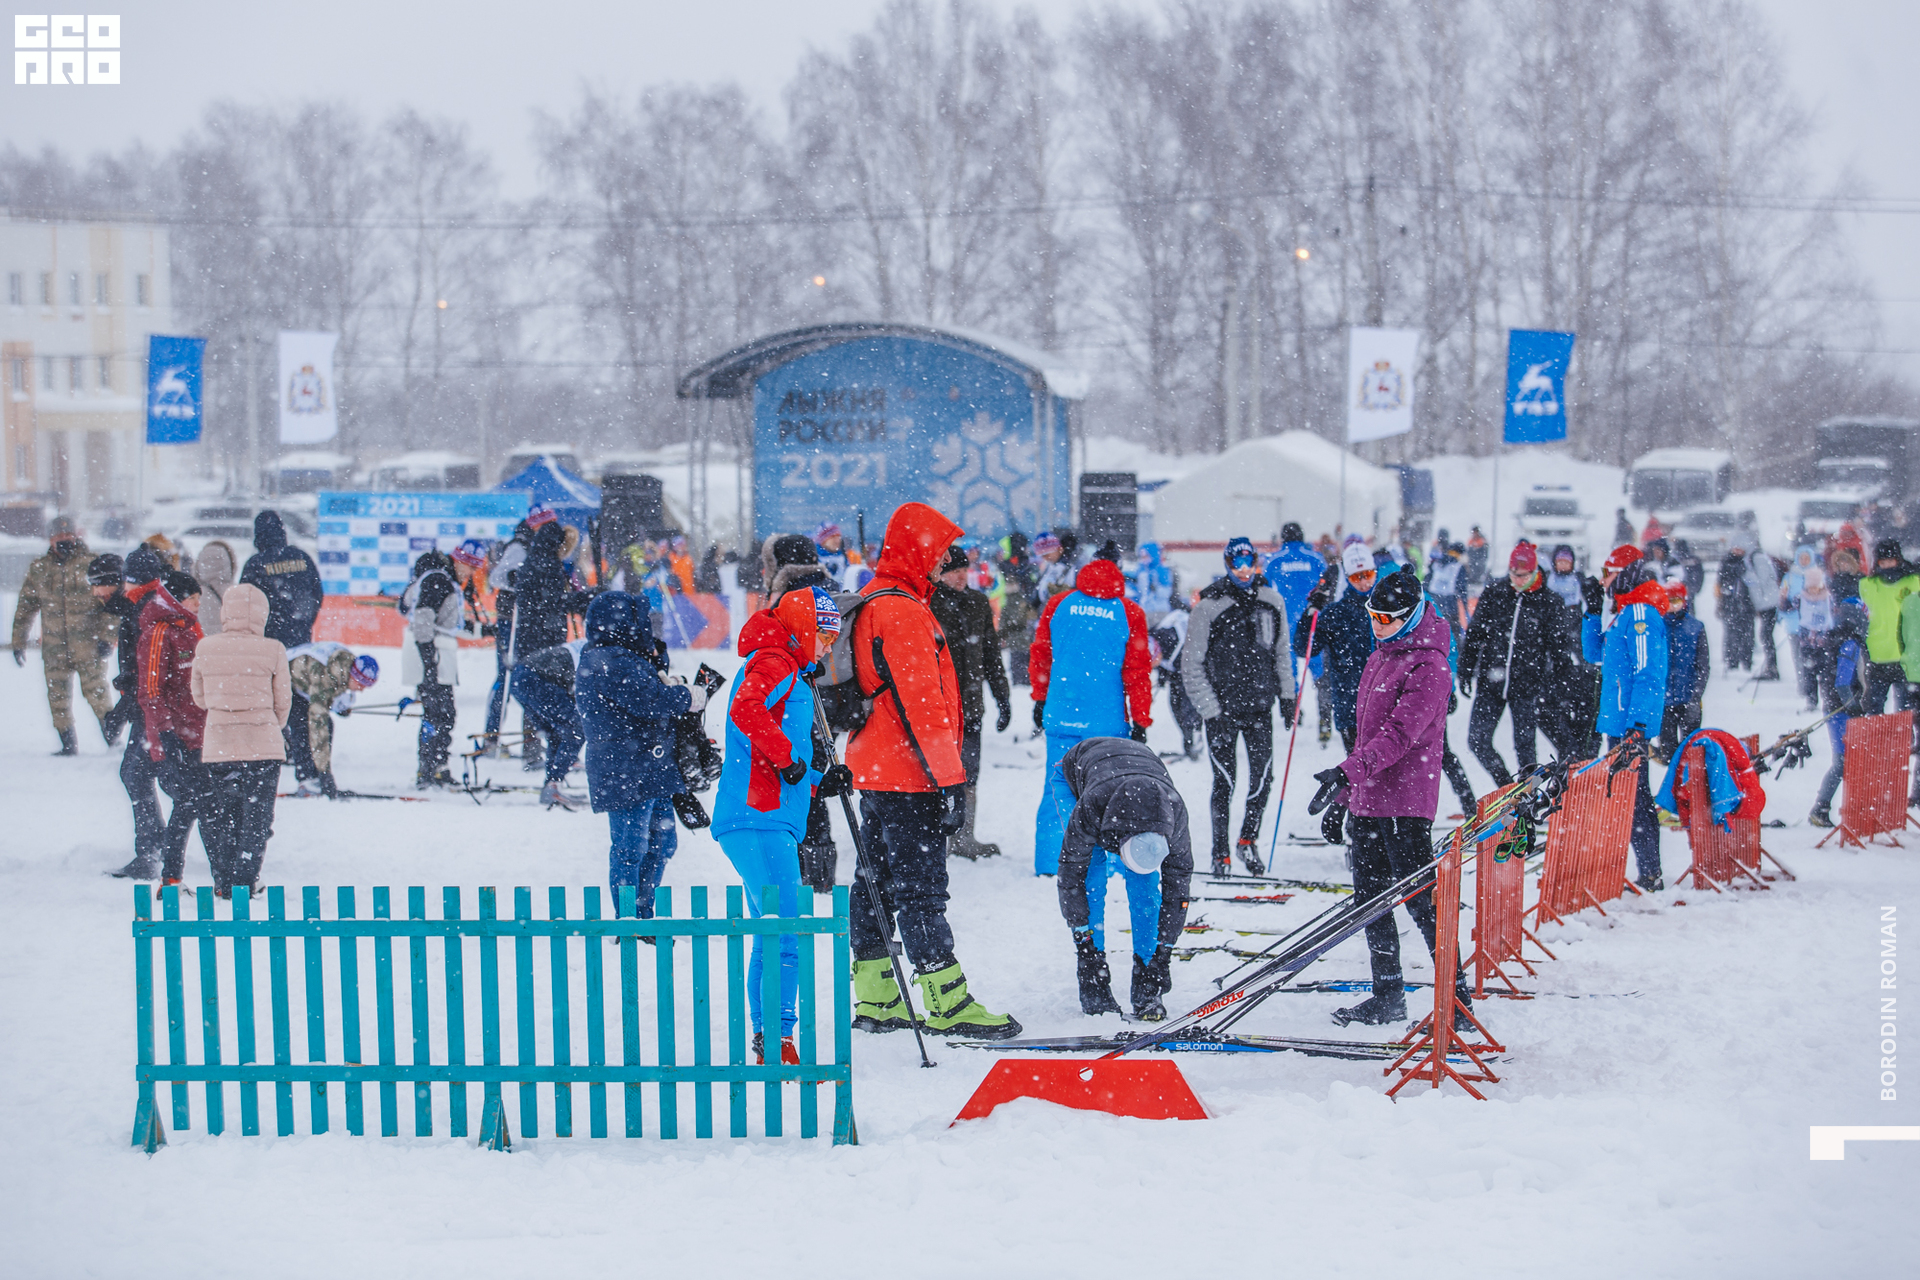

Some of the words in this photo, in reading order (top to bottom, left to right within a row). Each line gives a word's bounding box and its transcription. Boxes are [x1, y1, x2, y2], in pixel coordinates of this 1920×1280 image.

[780, 453, 887, 487] 2021
[369, 497, 419, 515] 2021
[1070, 605, 1115, 620] RUSSIA
[1197, 989, 1245, 1018] ATOMIC
[1175, 1042, 1224, 1051] salomon
